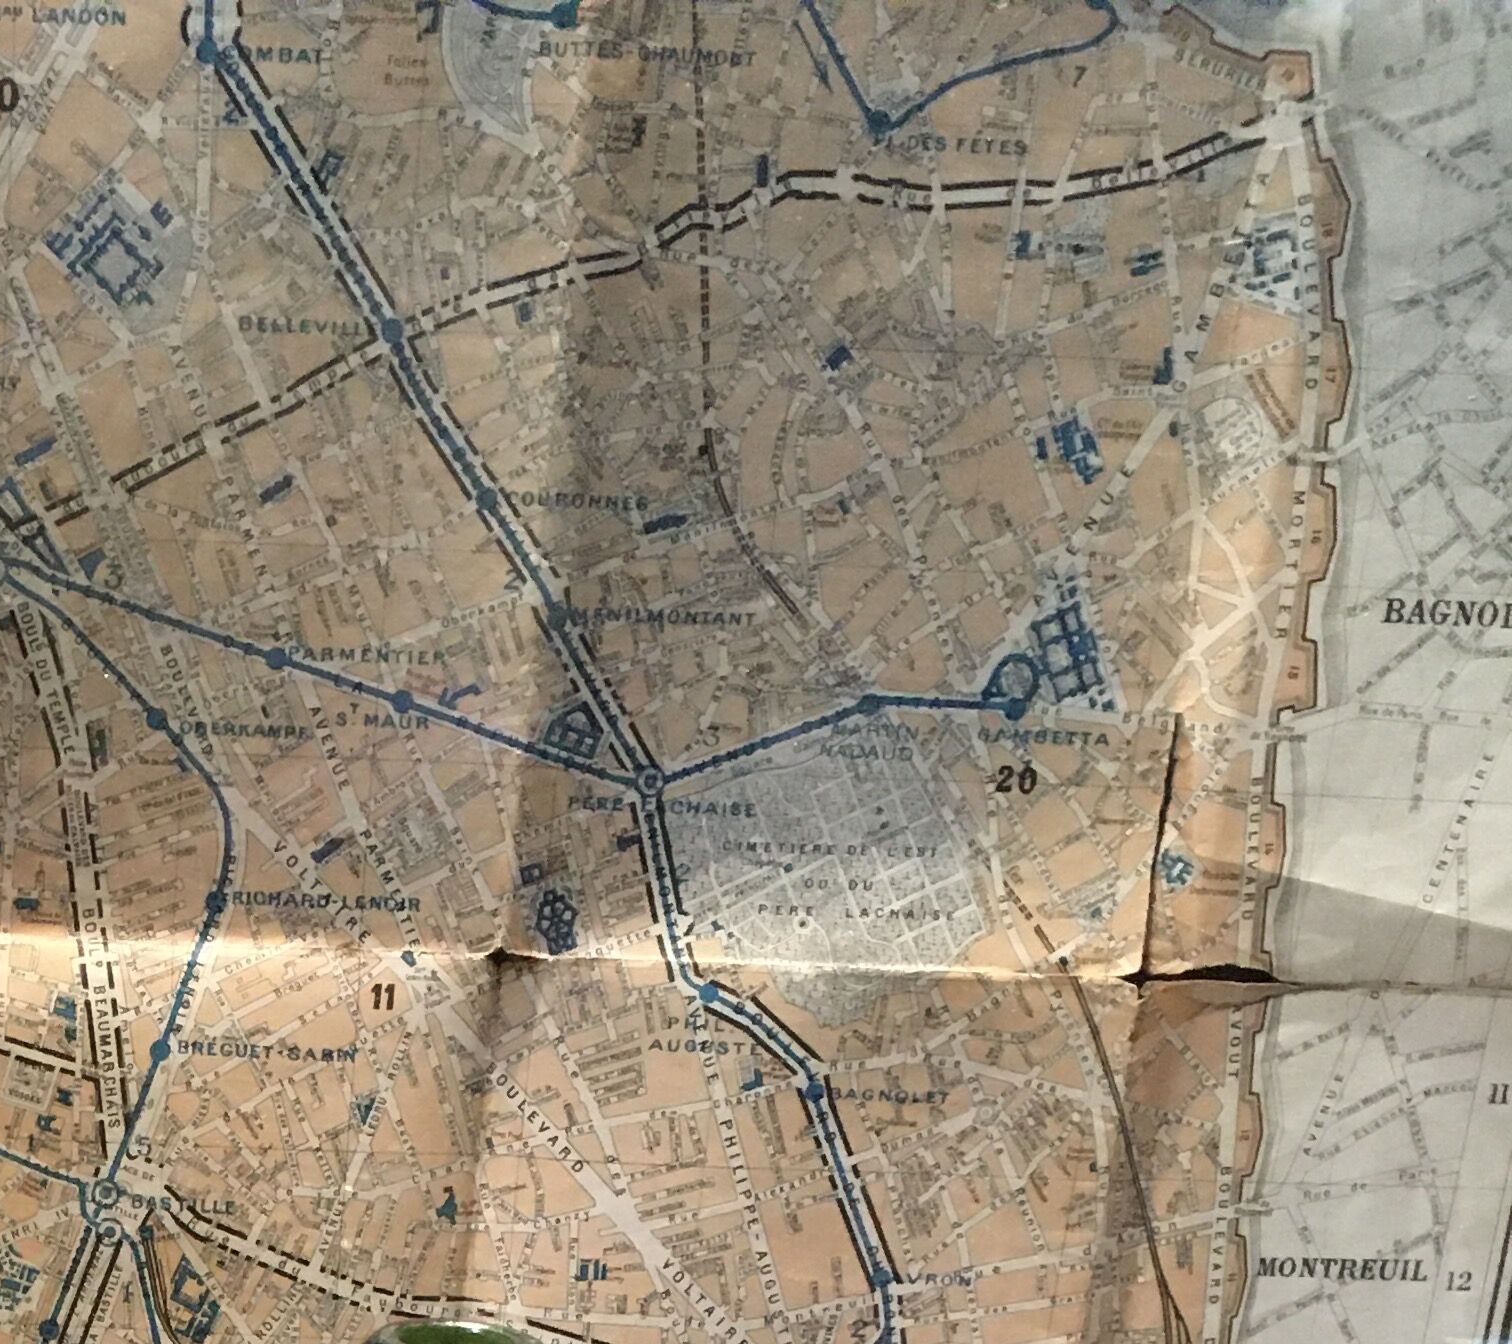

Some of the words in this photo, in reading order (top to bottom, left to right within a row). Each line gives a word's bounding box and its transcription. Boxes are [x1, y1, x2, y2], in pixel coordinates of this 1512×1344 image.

[31, 8, 127, 28] LANDON
[224, 43, 324, 67] COMBAT
[906, 133, 946, 154] DES
[1296, 192, 1322, 392] BOULEVARD
[1273, 488, 1308, 641] MORTIER
[288, 644, 449, 668] PARMENTIER
[34, 655, 53, 683] DU
[46, 687, 79, 758] TEMPLE
[179, 720, 313, 741] OBERKAMPF
[364, 712, 430, 731] MAUR
[308, 704, 351, 794] AVENUE
[977, 726, 1112, 748] GAMBETTA
[994, 764, 1039, 796] 20
[1422, 750, 1498, 906] CENTENAIRE
[846, 843, 870, 857] DE
[1240, 774, 1263, 922] BOULEVARD
[848, 877, 875, 893] DU
[844, 906, 958, 924] LACHAISE
[370, 980, 396, 1012] 11
[93, 983, 124, 1132] BEAUMARCHAIS
[831, 1086, 950, 1105] BAGNOLET
[1489, 1082, 1512, 1106] 11
[488, 1060, 586, 1177] BOULEVARD
[318, 1200, 344, 1256] AVENUE
[365, 1093, 388, 1139] LEDRU
[386, 1030, 413, 1082] ROLLIN
[1303, 1187, 1333, 1202] Rue
[1349, 1180, 1369, 1194] de
[1206, 1164, 1233, 1308] BOULEVARD
[1255, 1254, 1429, 1285] MONTREUIL
[1444, 1270, 1474, 1293] 12
